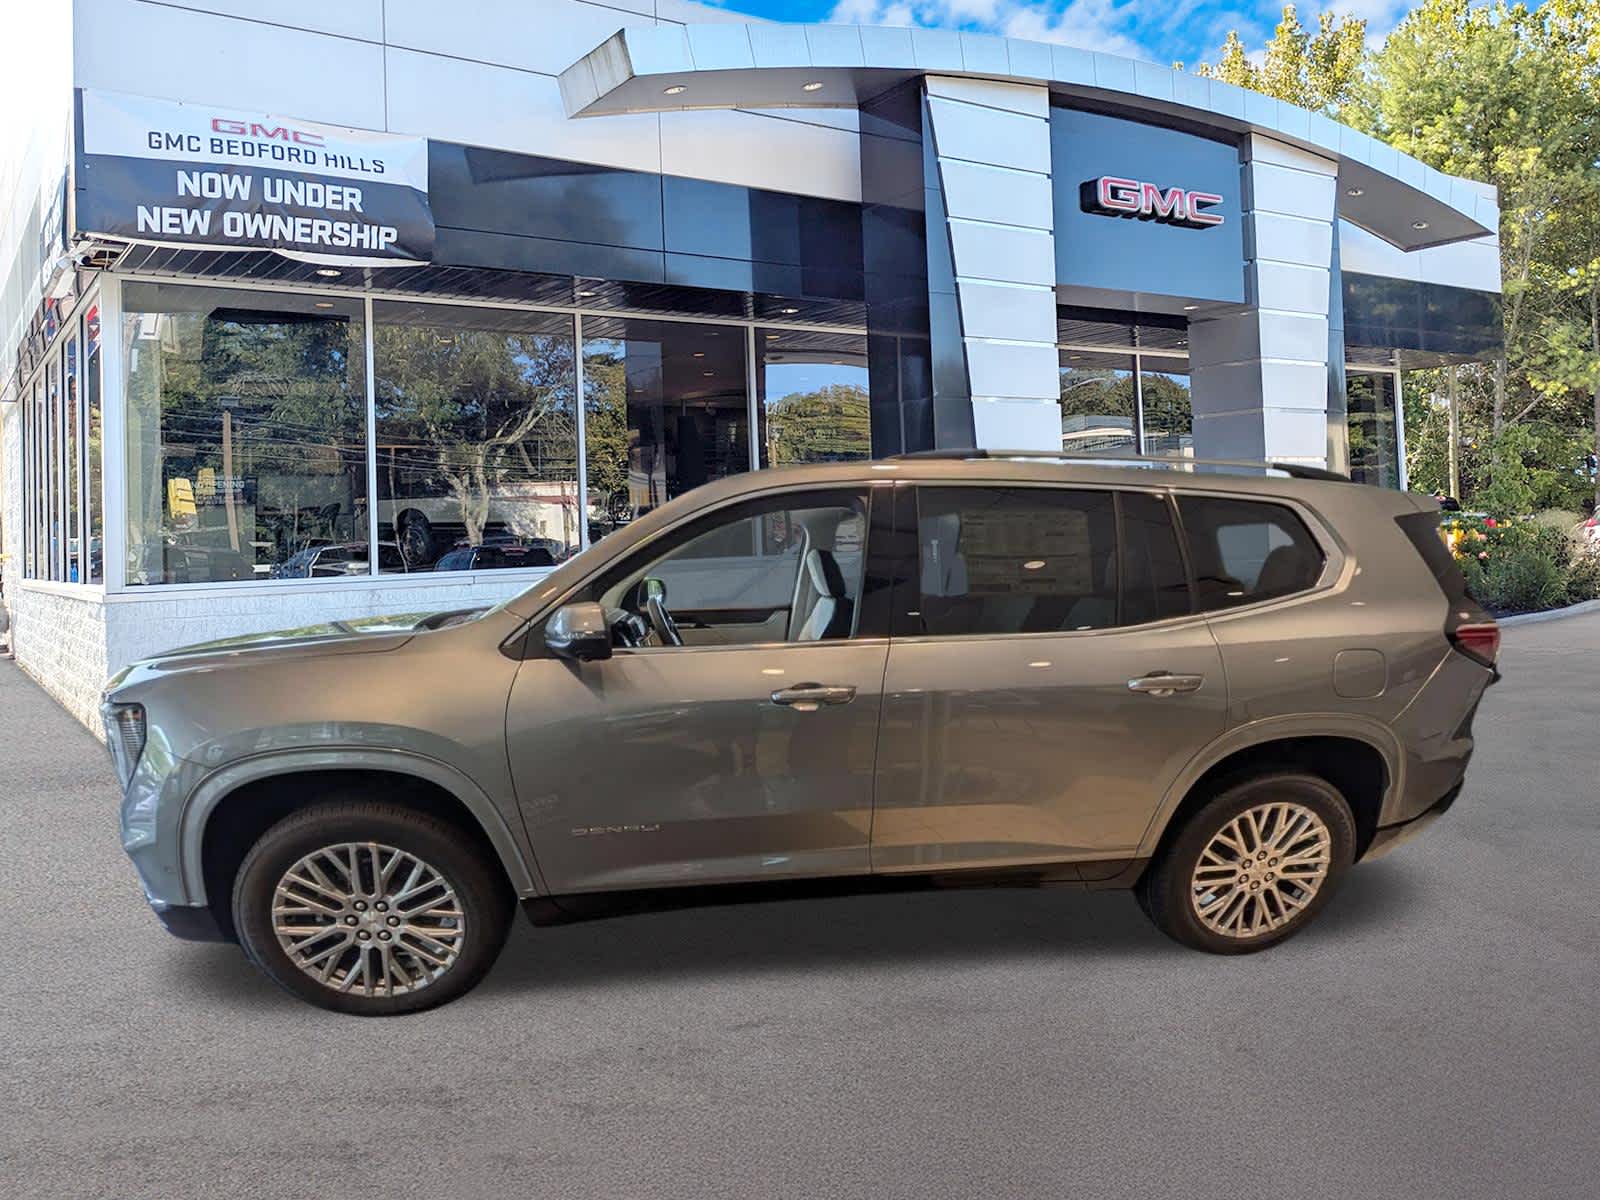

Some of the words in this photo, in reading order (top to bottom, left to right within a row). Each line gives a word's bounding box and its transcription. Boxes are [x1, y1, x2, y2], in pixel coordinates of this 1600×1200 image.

[148, 131, 201, 152] GMC
[210, 138, 316, 165] BEDFORD
[324, 153, 385, 174] HILLS
[211, 118, 326, 148] GMC
[177, 170, 252, 200] NOW
[263, 177, 363, 212] UNDER
[1097, 175, 1225, 225] GMC
[136, 205, 211, 236] NEW
[223, 211, 398, 250] OWNERSHIP
